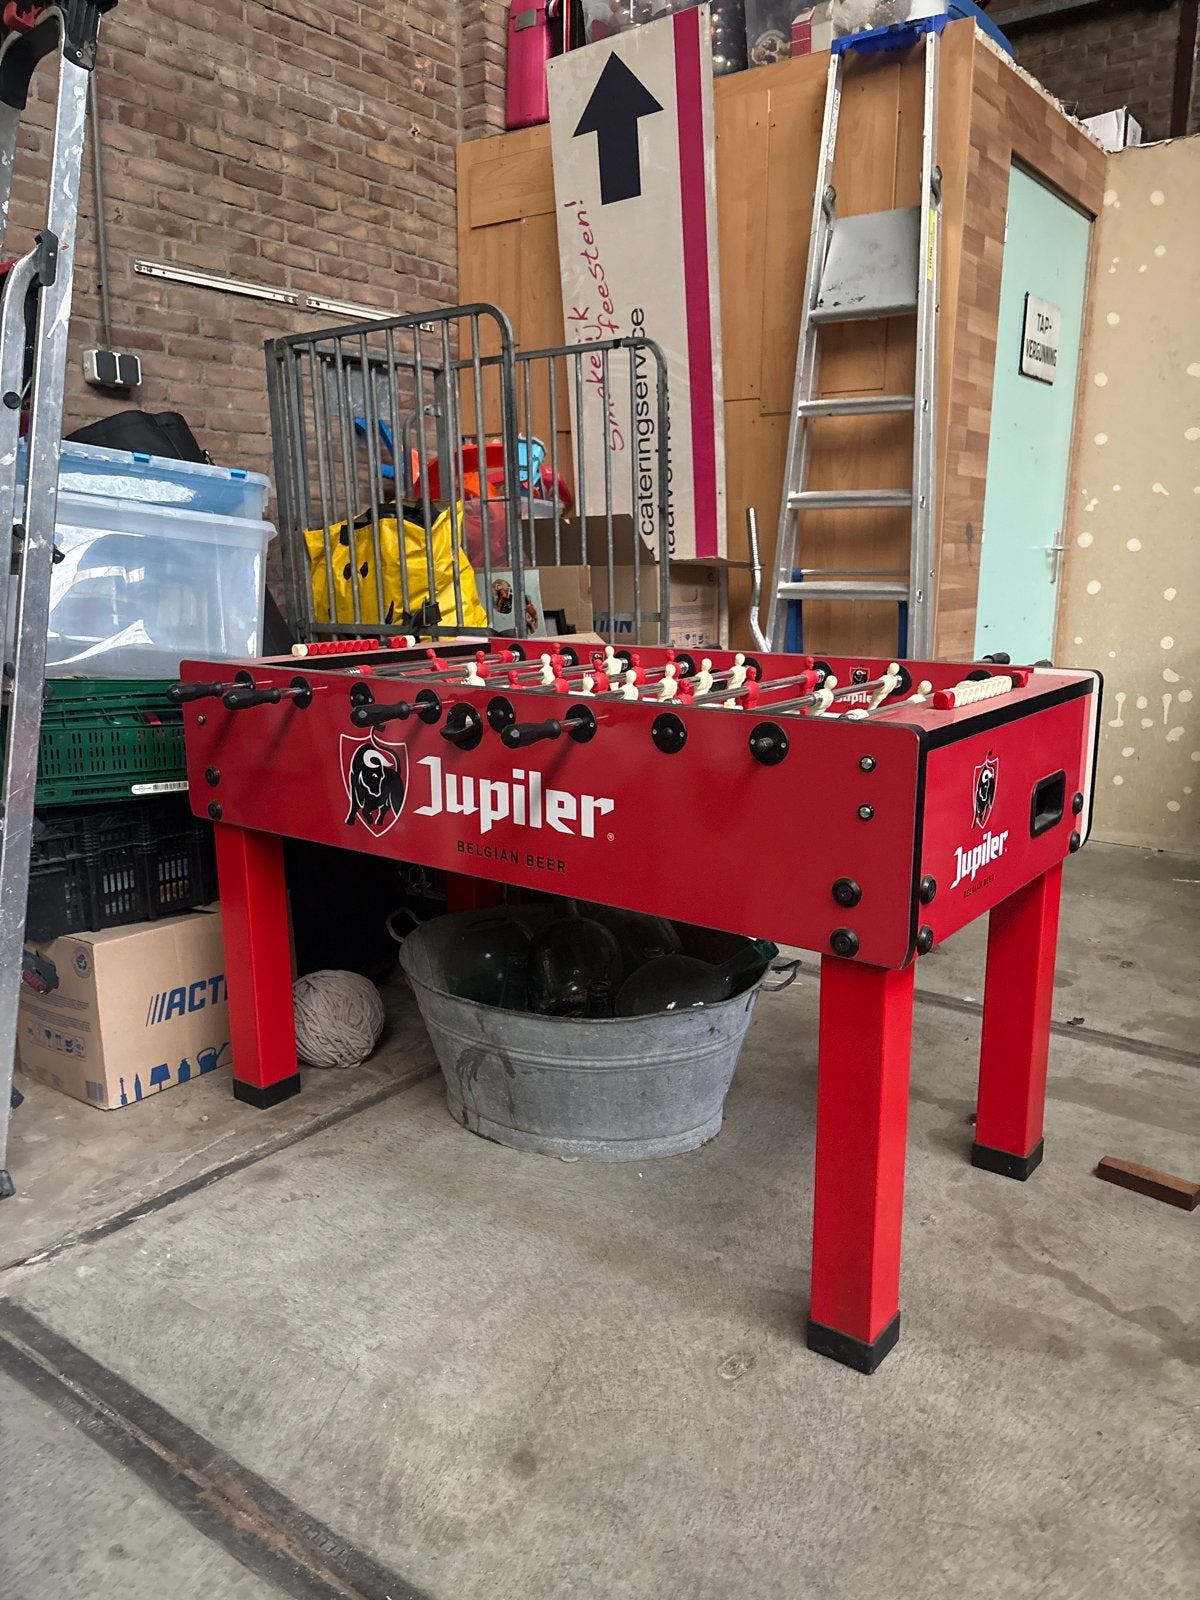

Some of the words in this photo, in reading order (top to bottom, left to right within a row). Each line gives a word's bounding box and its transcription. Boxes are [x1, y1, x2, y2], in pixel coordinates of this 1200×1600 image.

[564, 200, 620, 335] feesten!
[413, 755, 615, 838] Jupiler
[457, 840, 519, 864] BELGIAN
[526, 853, 566, 873] BEER
[950, 830, 1009, 889] Jupiler
